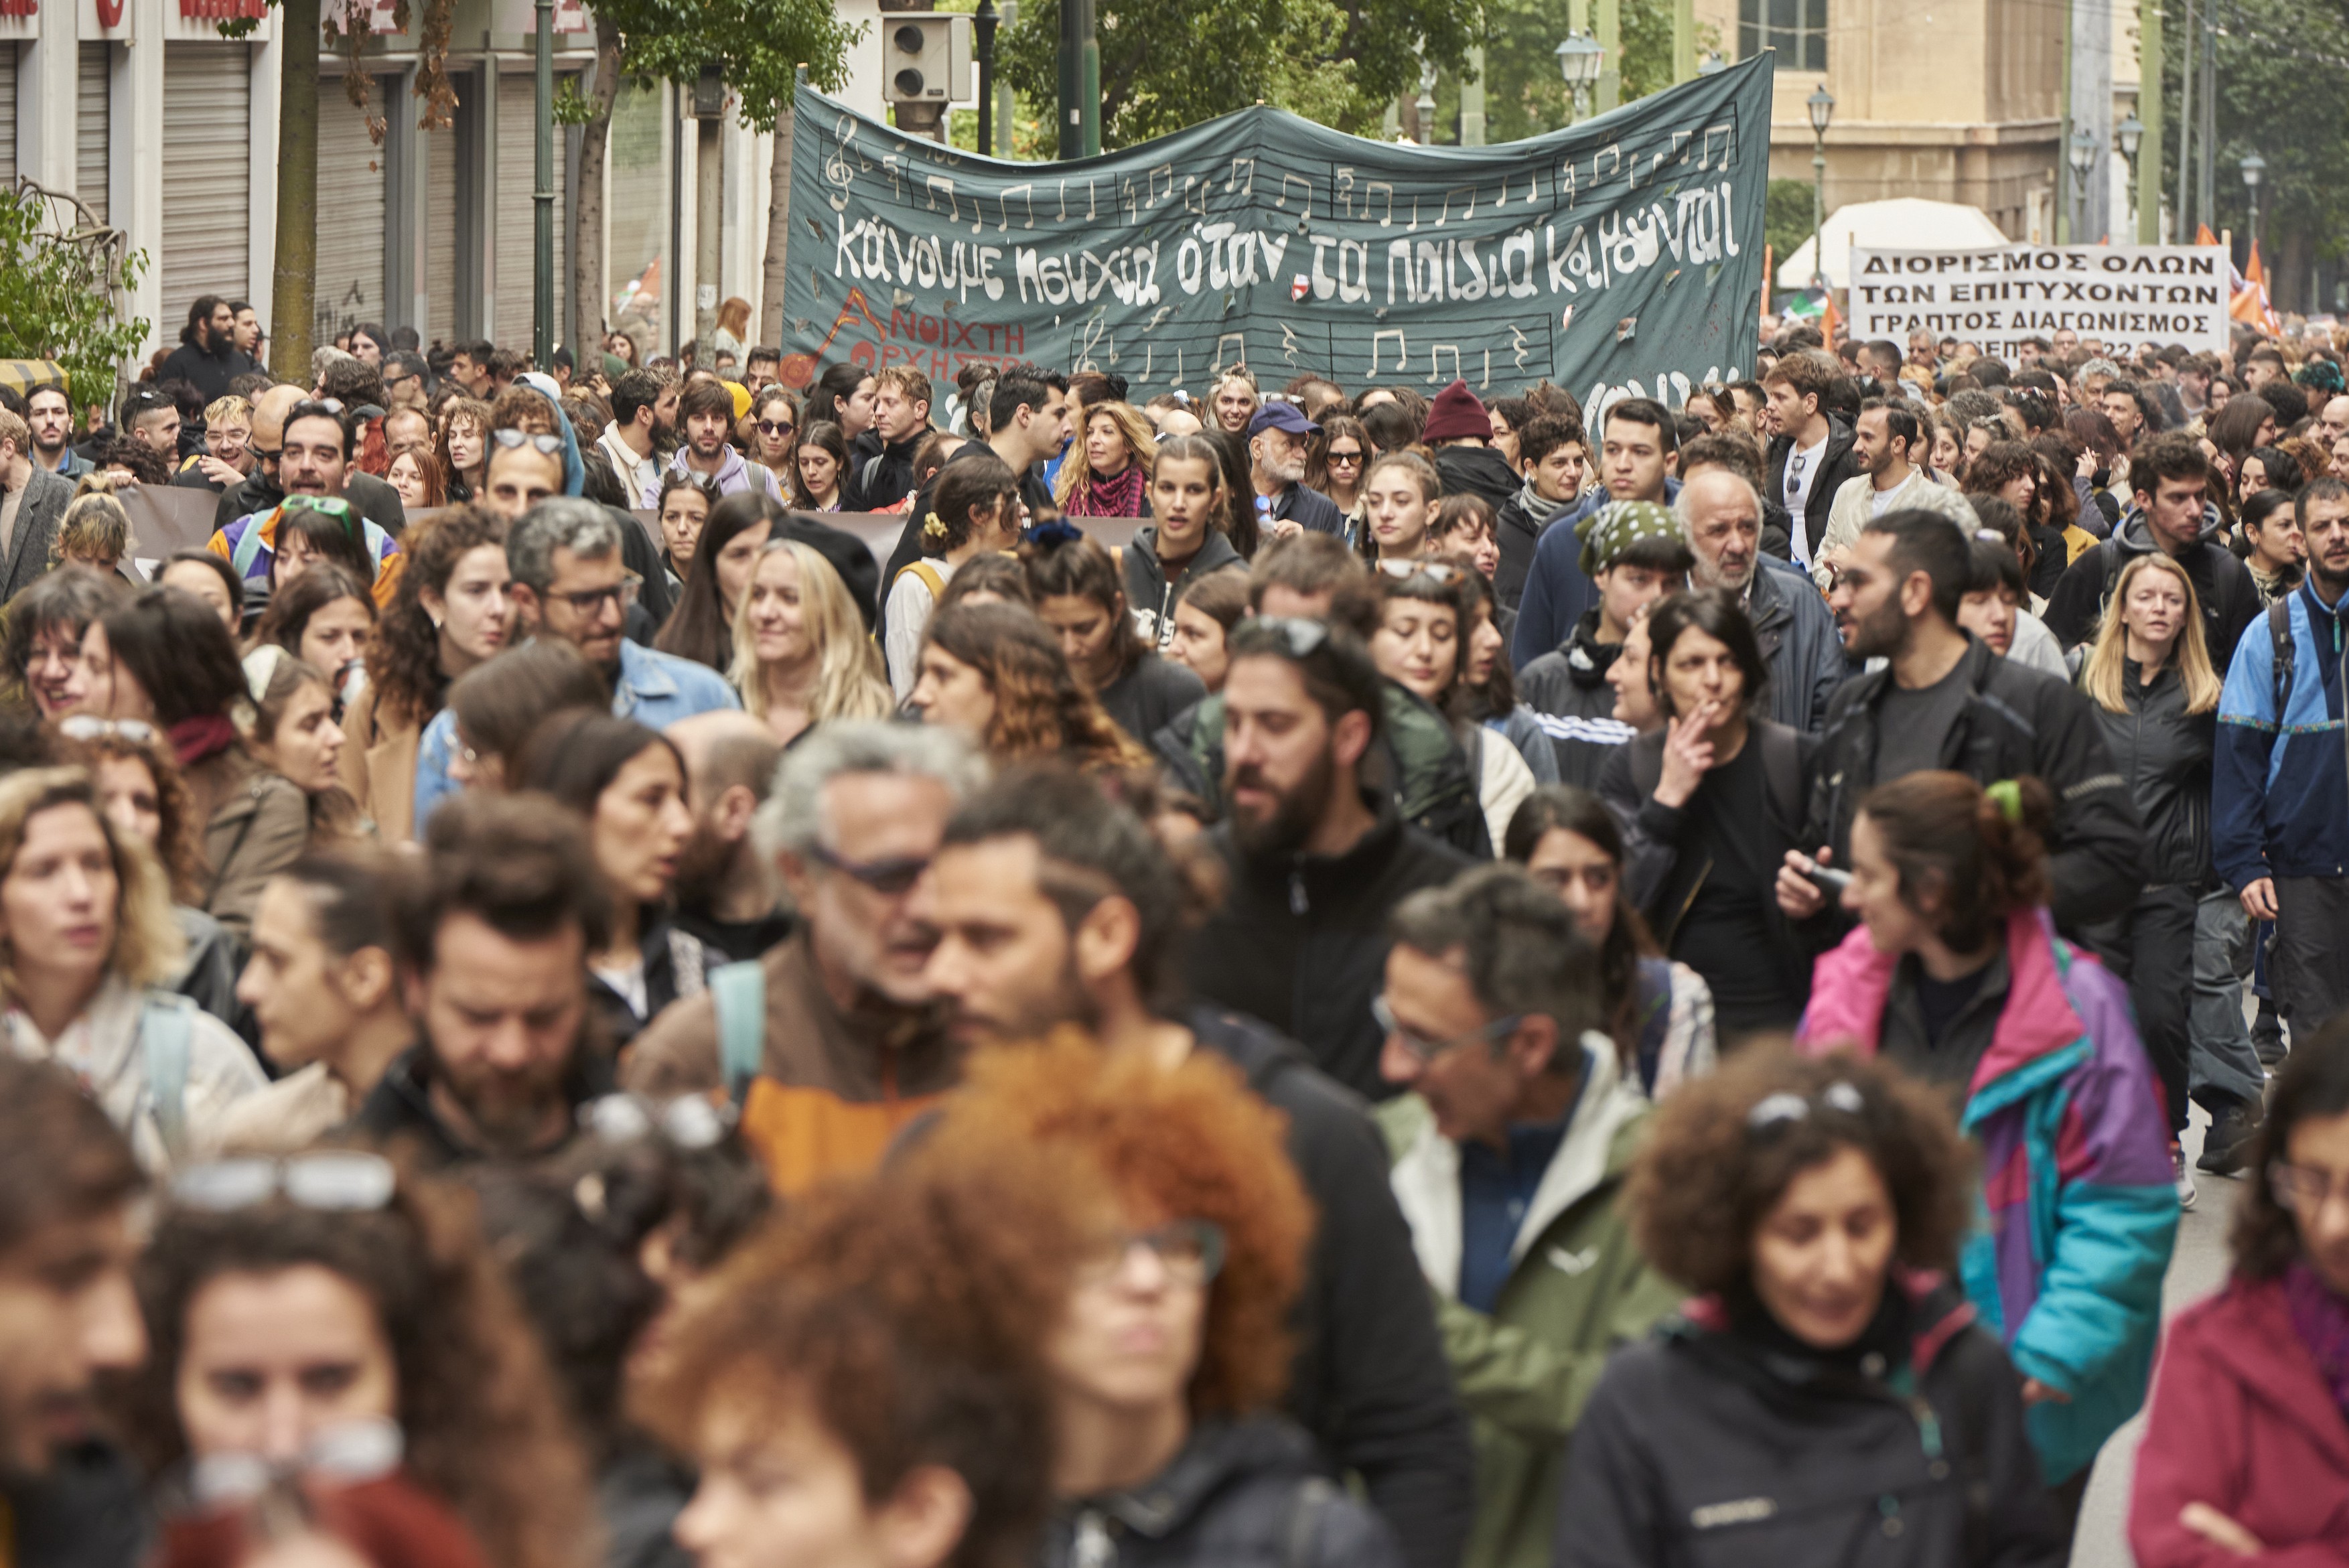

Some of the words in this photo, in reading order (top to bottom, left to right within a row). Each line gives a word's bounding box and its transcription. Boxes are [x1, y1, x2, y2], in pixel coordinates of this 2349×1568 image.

[1309, 235, 1370, 303] τα
[1863, 252, 2087, 274] ΔΙΟΡΙΣΜΟΣ
[2102, 255, 2214, 275] ΟΛΩΝ
[1859, 284, 1935, 303] ΤΩΝ
[1950, 281, 2217, 304] ΕΠΙΤΥΧΟΝΤΩΝ
[1870, 311, 2002, 332] ΓΡΑΠΤΟΣ
[2011, 311, 2208, 333] ΔΙΑΓΩΝΙΣΜΟΣ
